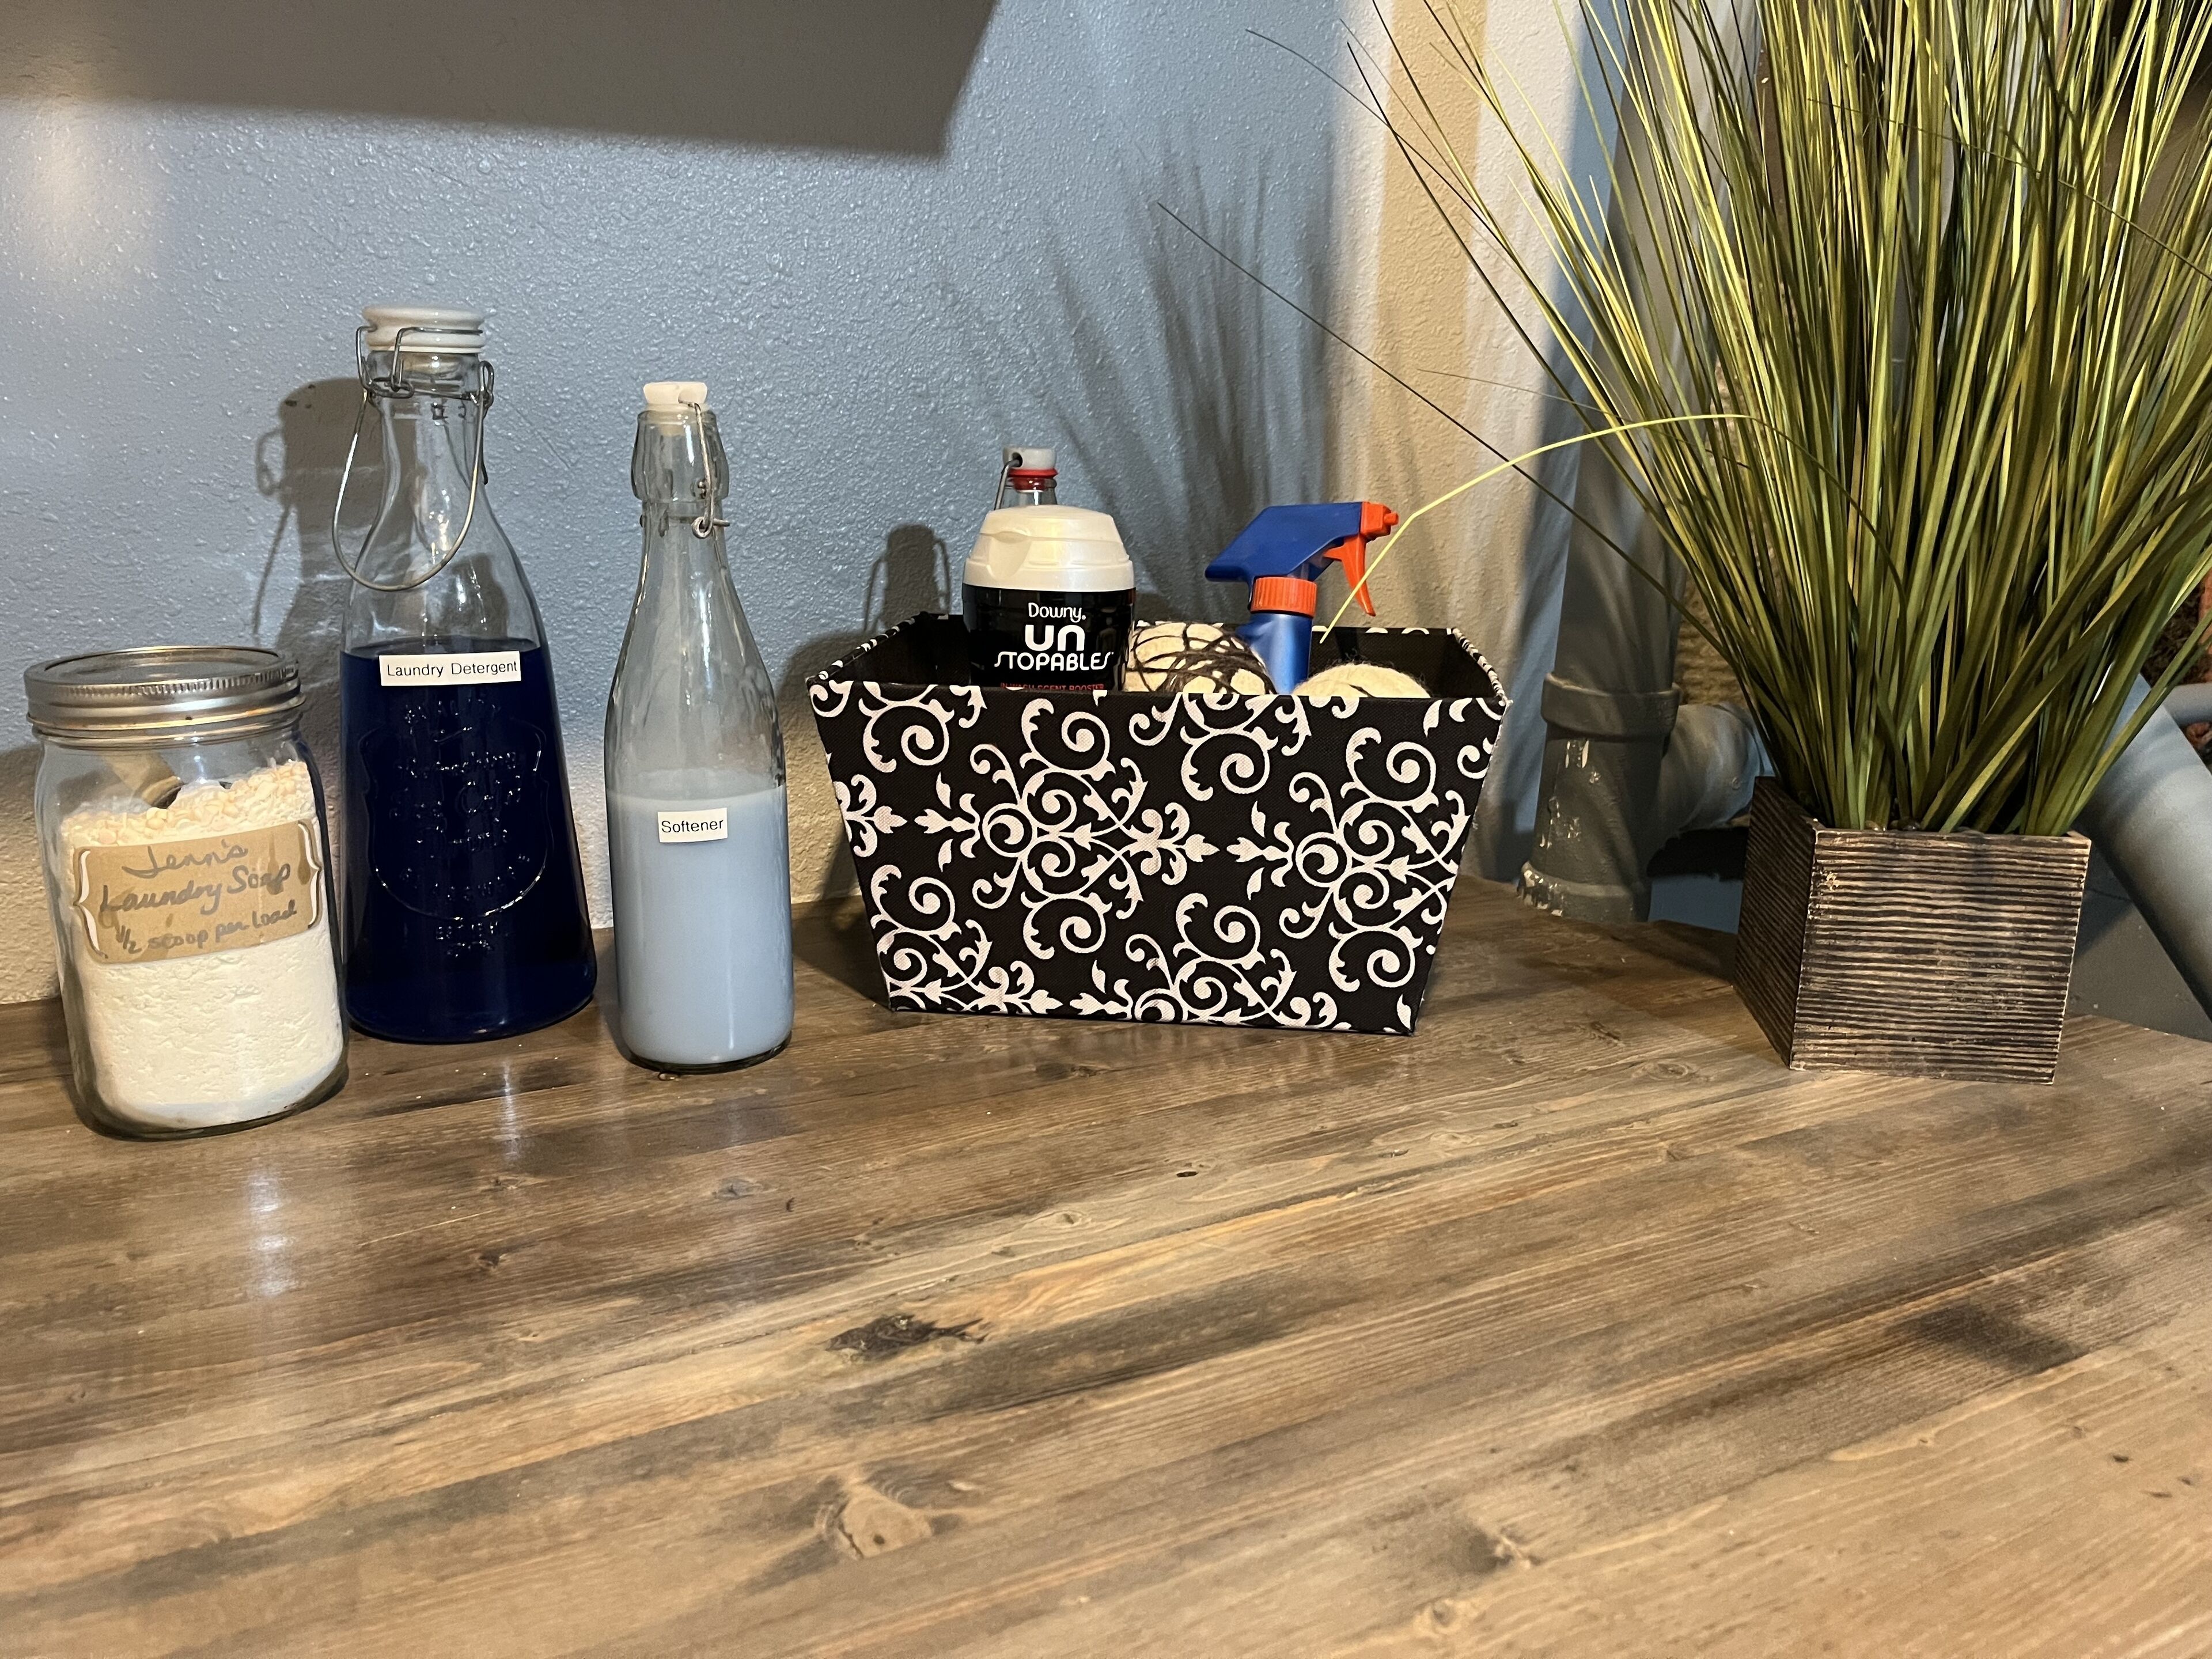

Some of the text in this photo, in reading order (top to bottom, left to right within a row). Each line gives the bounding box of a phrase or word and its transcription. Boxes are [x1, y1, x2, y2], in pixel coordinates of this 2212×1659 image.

[387, 660, 517, 678] Laundry Detergent
[994, 651, 1111, 671] STOPABLES
[661, 819, 724, 834] Softener
[99, 863, 291, 915] Laundry Soap
[147, 929, 209, 949] scoop
